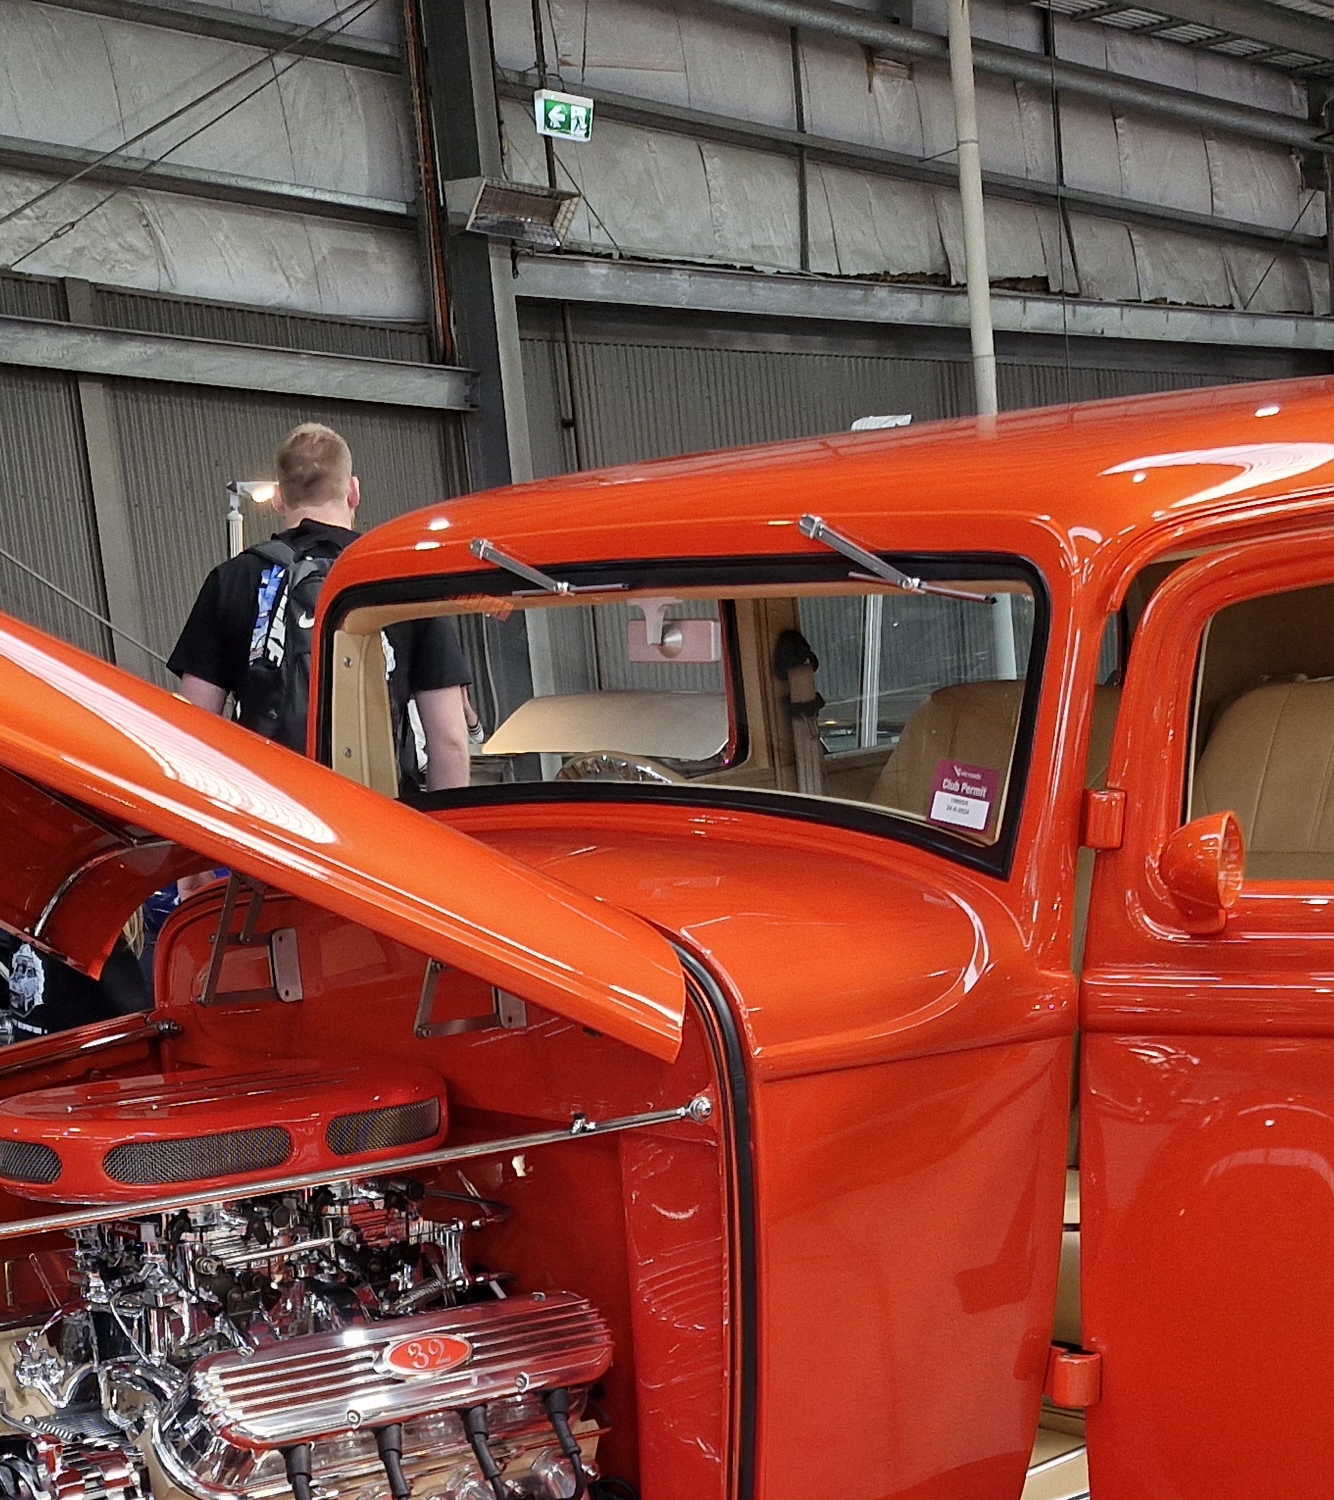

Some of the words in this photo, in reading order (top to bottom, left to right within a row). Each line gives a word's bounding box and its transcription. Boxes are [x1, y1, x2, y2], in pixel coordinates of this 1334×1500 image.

[942, 778, 960, 792] Club
[960, 782, 987, 798] Permit
[407, 1338, 452, 1369] 32
